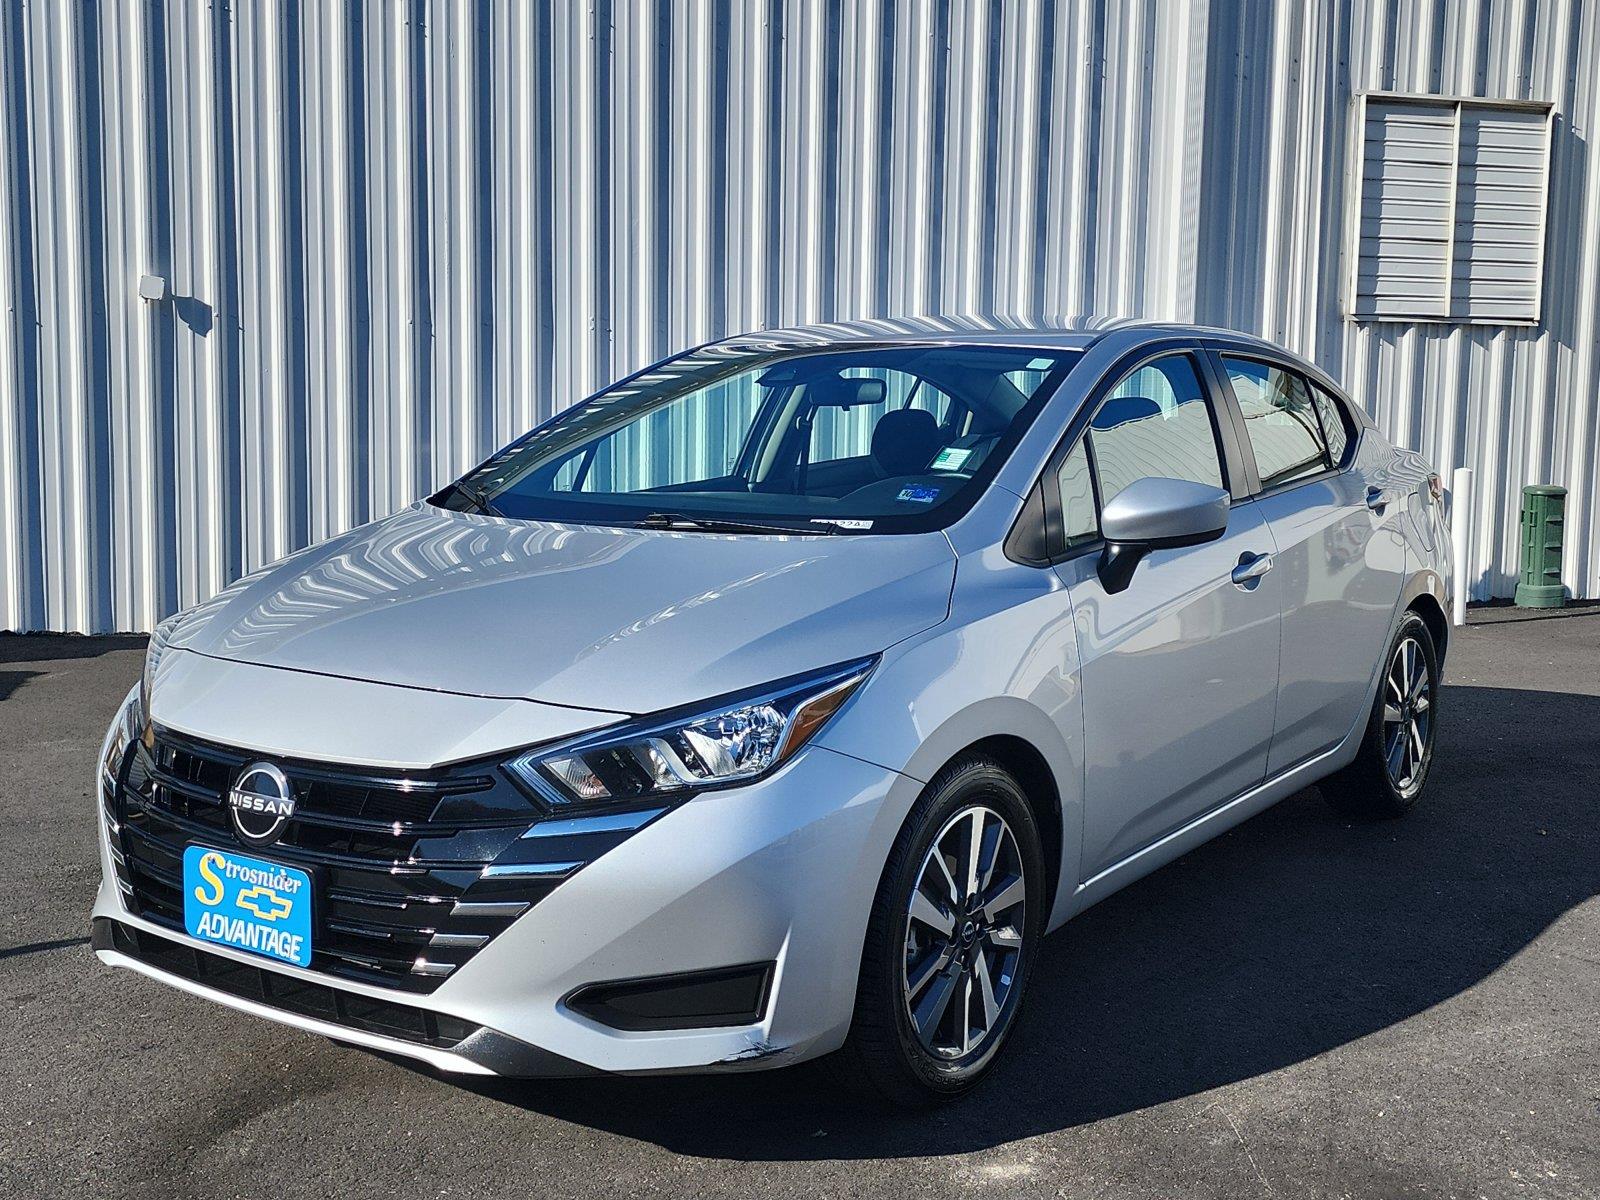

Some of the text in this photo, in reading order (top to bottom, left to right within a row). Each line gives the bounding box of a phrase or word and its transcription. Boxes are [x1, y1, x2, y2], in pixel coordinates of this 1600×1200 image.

[229, 791, 294, 816] NISSAN
[194, 852, 302, 906] Strosnider
[197, 911, 303, 961] ADVANTAGE
